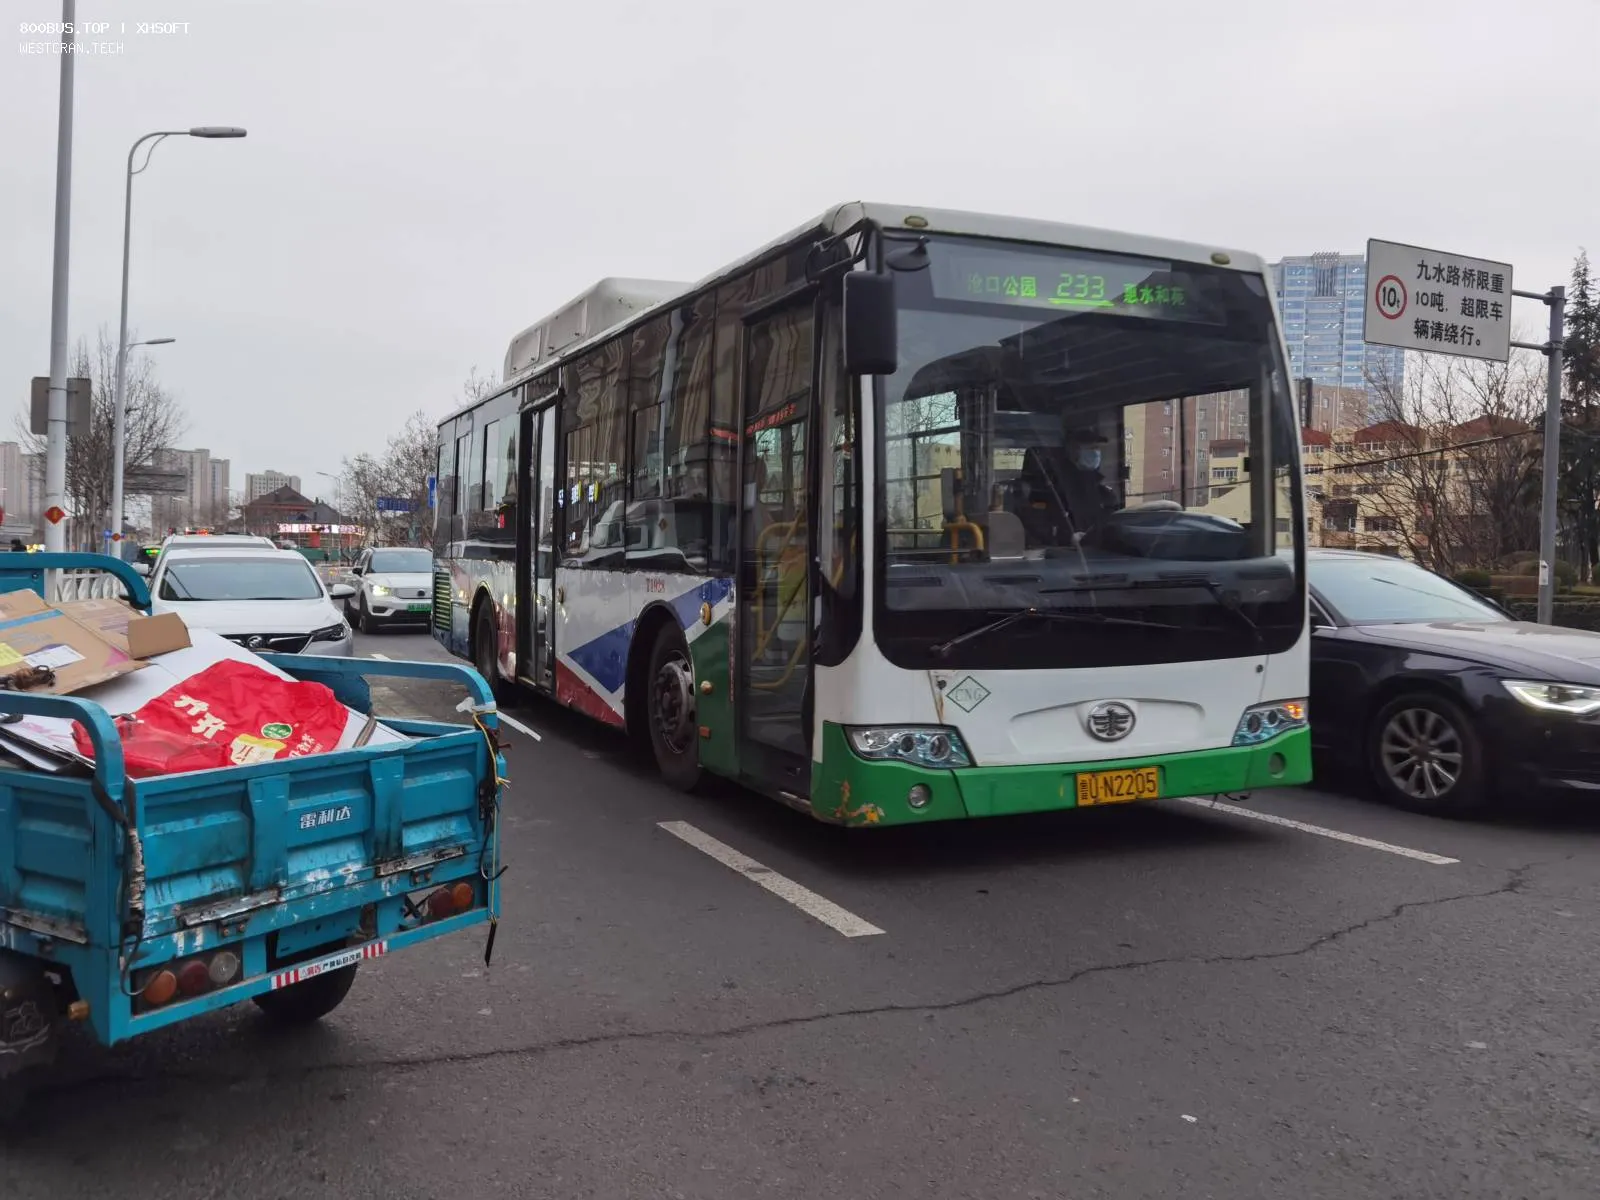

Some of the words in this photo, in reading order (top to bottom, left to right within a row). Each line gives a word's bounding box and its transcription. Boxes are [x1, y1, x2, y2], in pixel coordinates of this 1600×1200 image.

[1056, 273, 1105, 298] 233
[1416, 259, 1504, 294] 九水路桥限重
[955, 687, 983, 702] CNG
[300, 805, 351, 829] 雷利达
